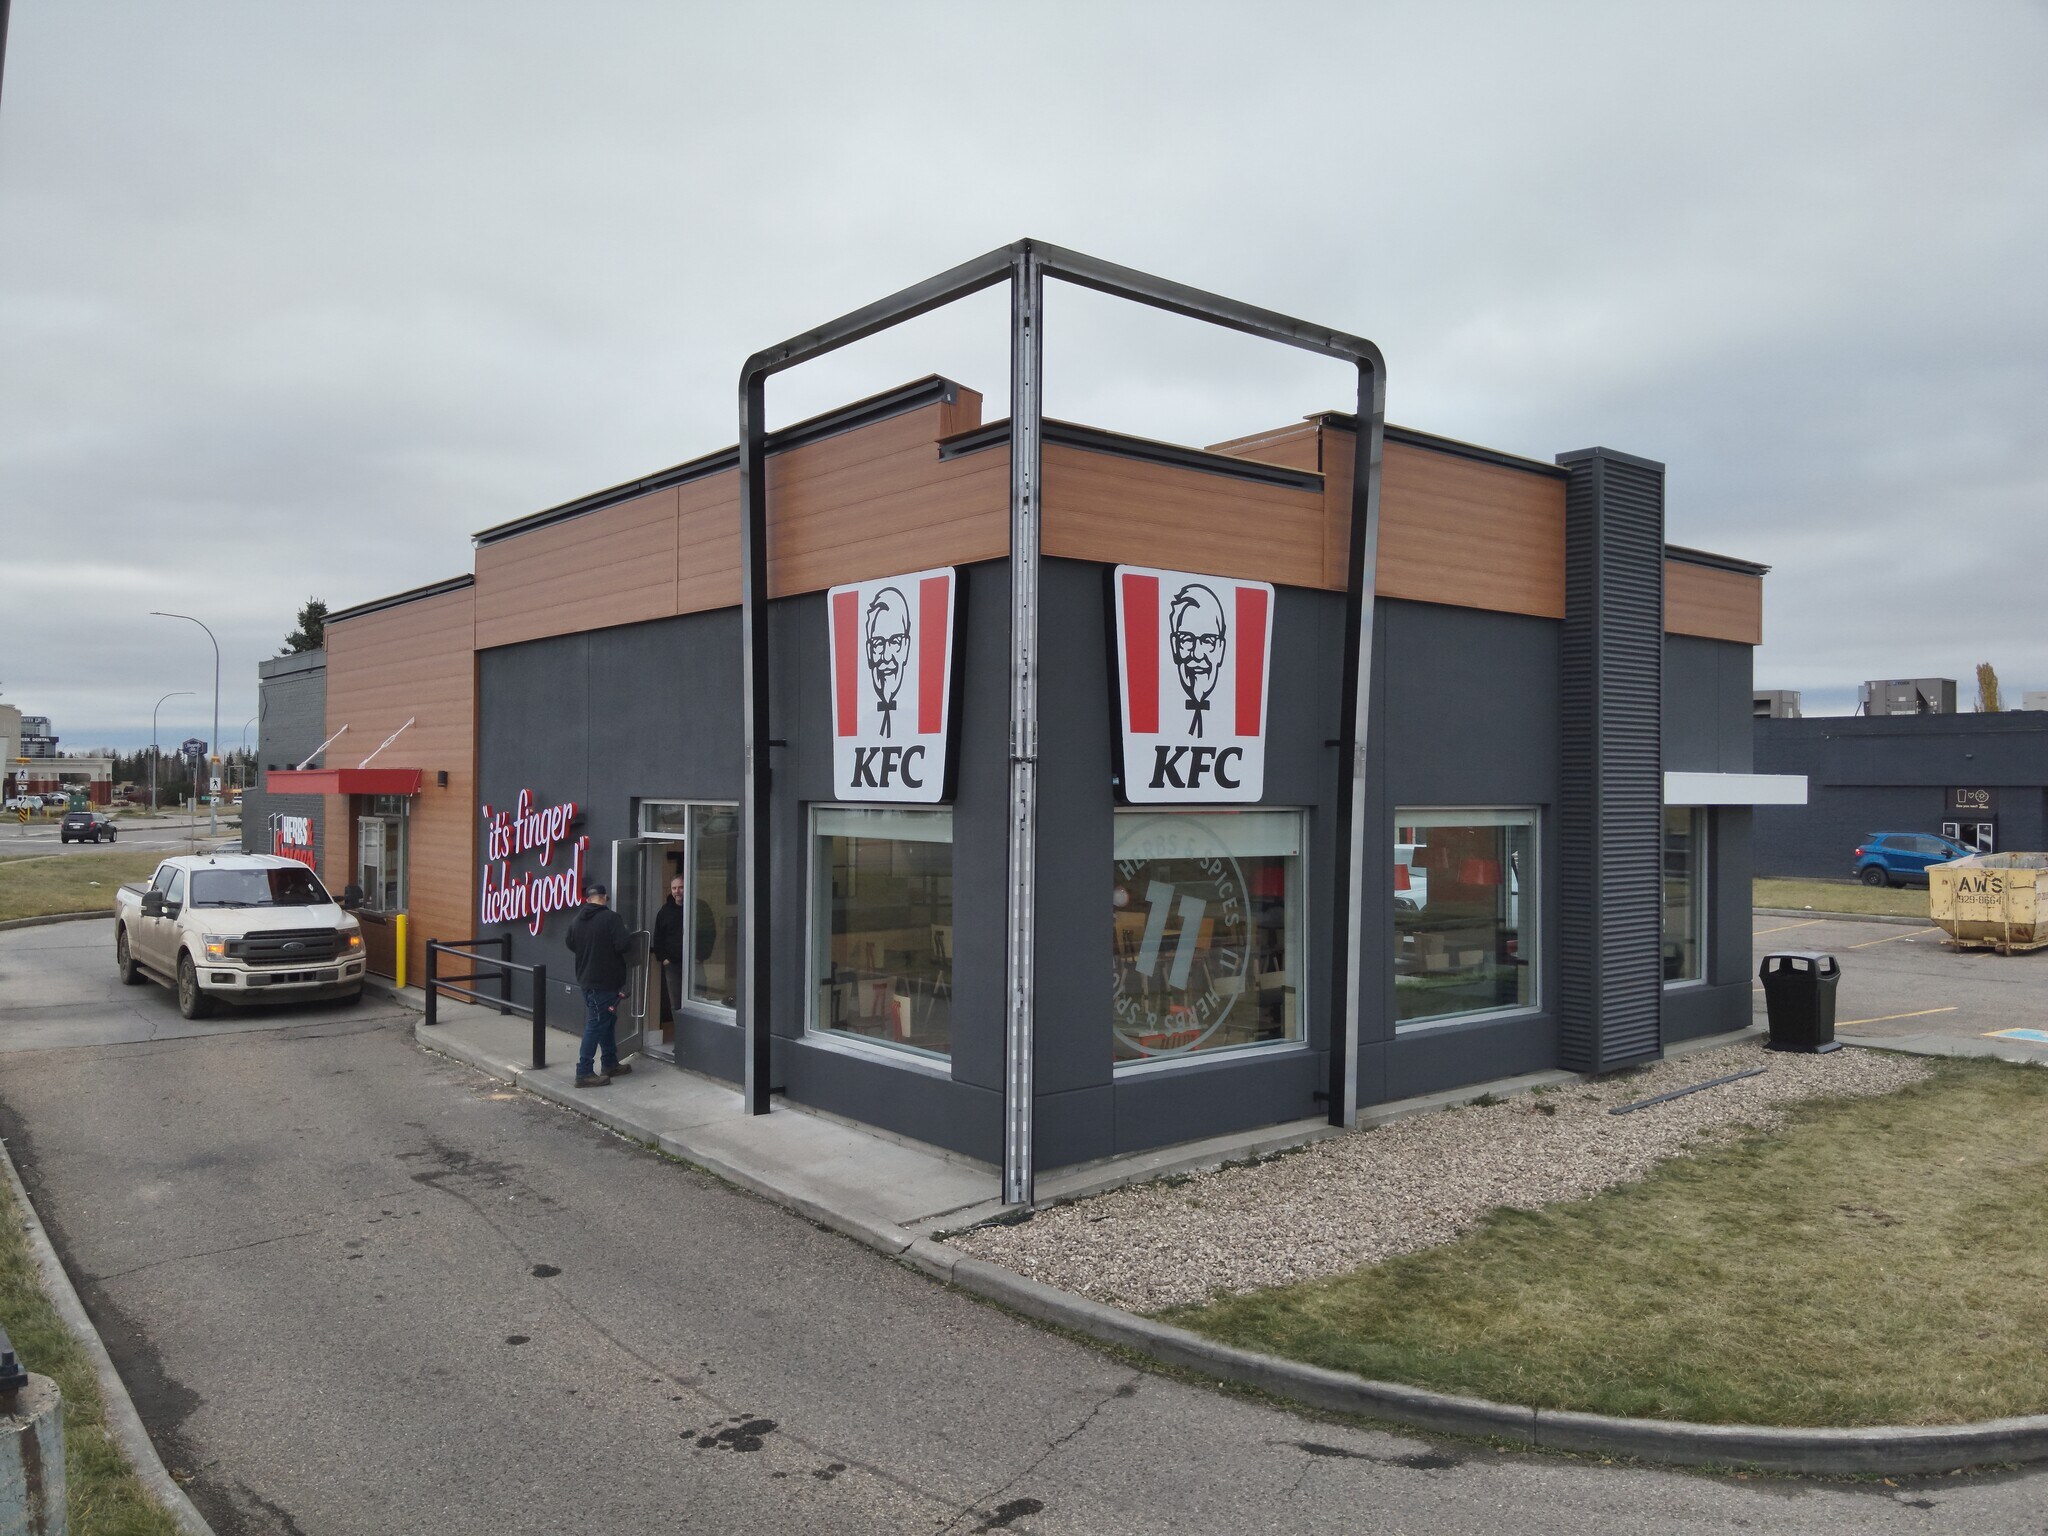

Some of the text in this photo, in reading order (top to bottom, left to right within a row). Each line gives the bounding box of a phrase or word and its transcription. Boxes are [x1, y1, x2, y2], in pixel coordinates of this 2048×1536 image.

[850, 745, 925, 788] KFC
[1148, 745, 1242, 789] KFC
[283, 816, 314, 847] HERBS &
[513, 788, 578, 867] finger
[1184, 838, 1196, 860] &
[1118, 833, 1178, 881] HERBS
[481, 860, 532, 924] lickin'
[1200, 848, 1240, 928] SPICES
[1958, 876, 2003, 893] AWS
[1134, 879, 1207, 991] 11
[1164, 986, 1221, 1037] HERBS
